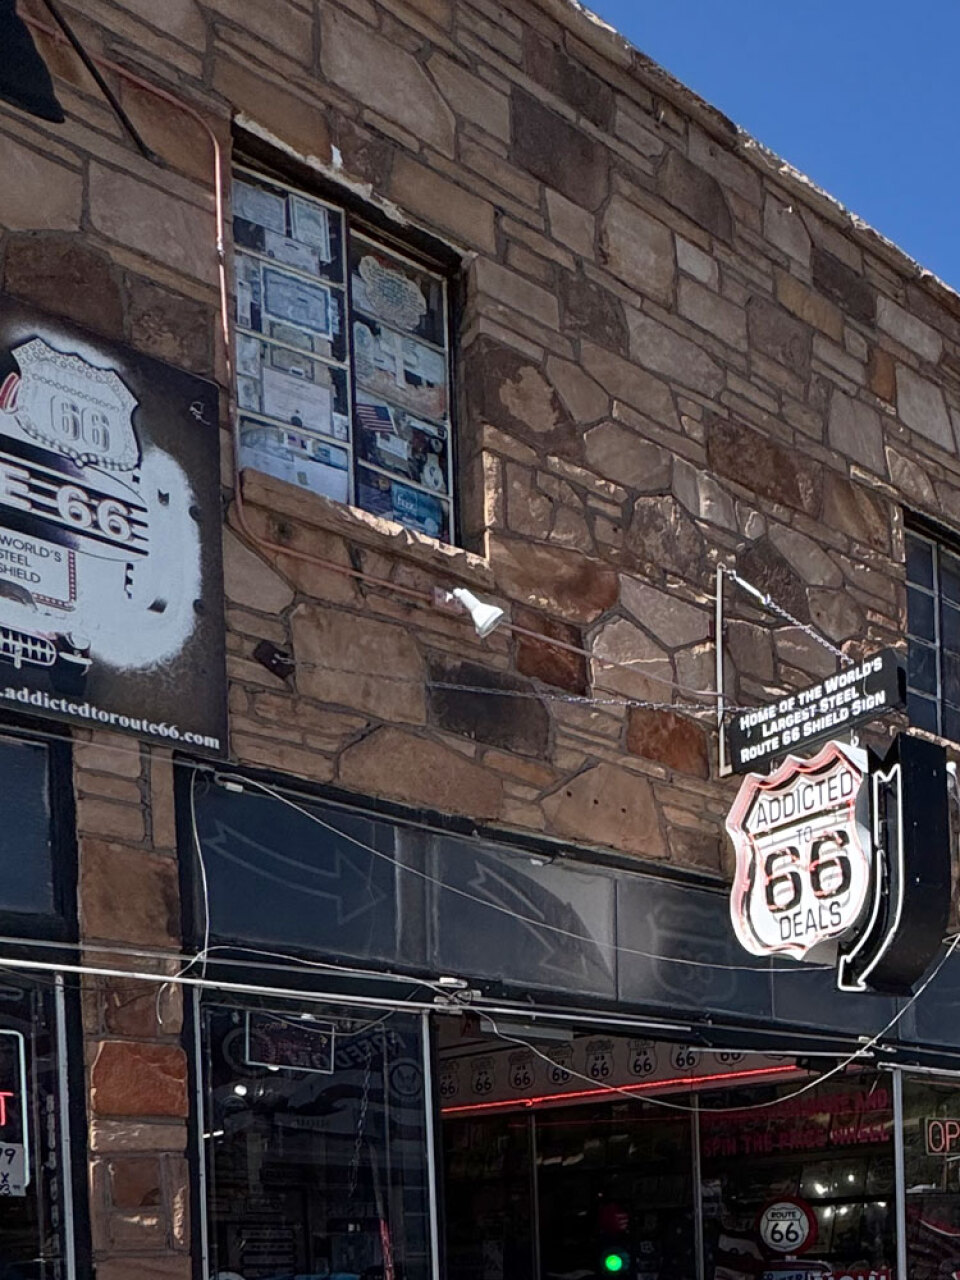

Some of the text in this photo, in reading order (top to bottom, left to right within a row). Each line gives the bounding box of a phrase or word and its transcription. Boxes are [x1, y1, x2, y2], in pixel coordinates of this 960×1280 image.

[56, 483, 133, 542] 66
[740, 656, 883, 732] HOME OF THE WORLD'S
[762, 685, 860, 738] LARGEST STEEL
[740, 689, 886, 763] ROUTE 66 SHIELD SIGN
[756, 770, 854, 829] ADDICTED
[796, 826, 812, 846] TO
[764, 829, 852, 914] 66
[779, 900, 843, 942] DEALS
[591, 1063, 609, 1077] 66
[633, 1058, 652, 1073] 66
[771, 1211, 797, 1219] ROUTE
[771, 1222, 799, 1243] 66
